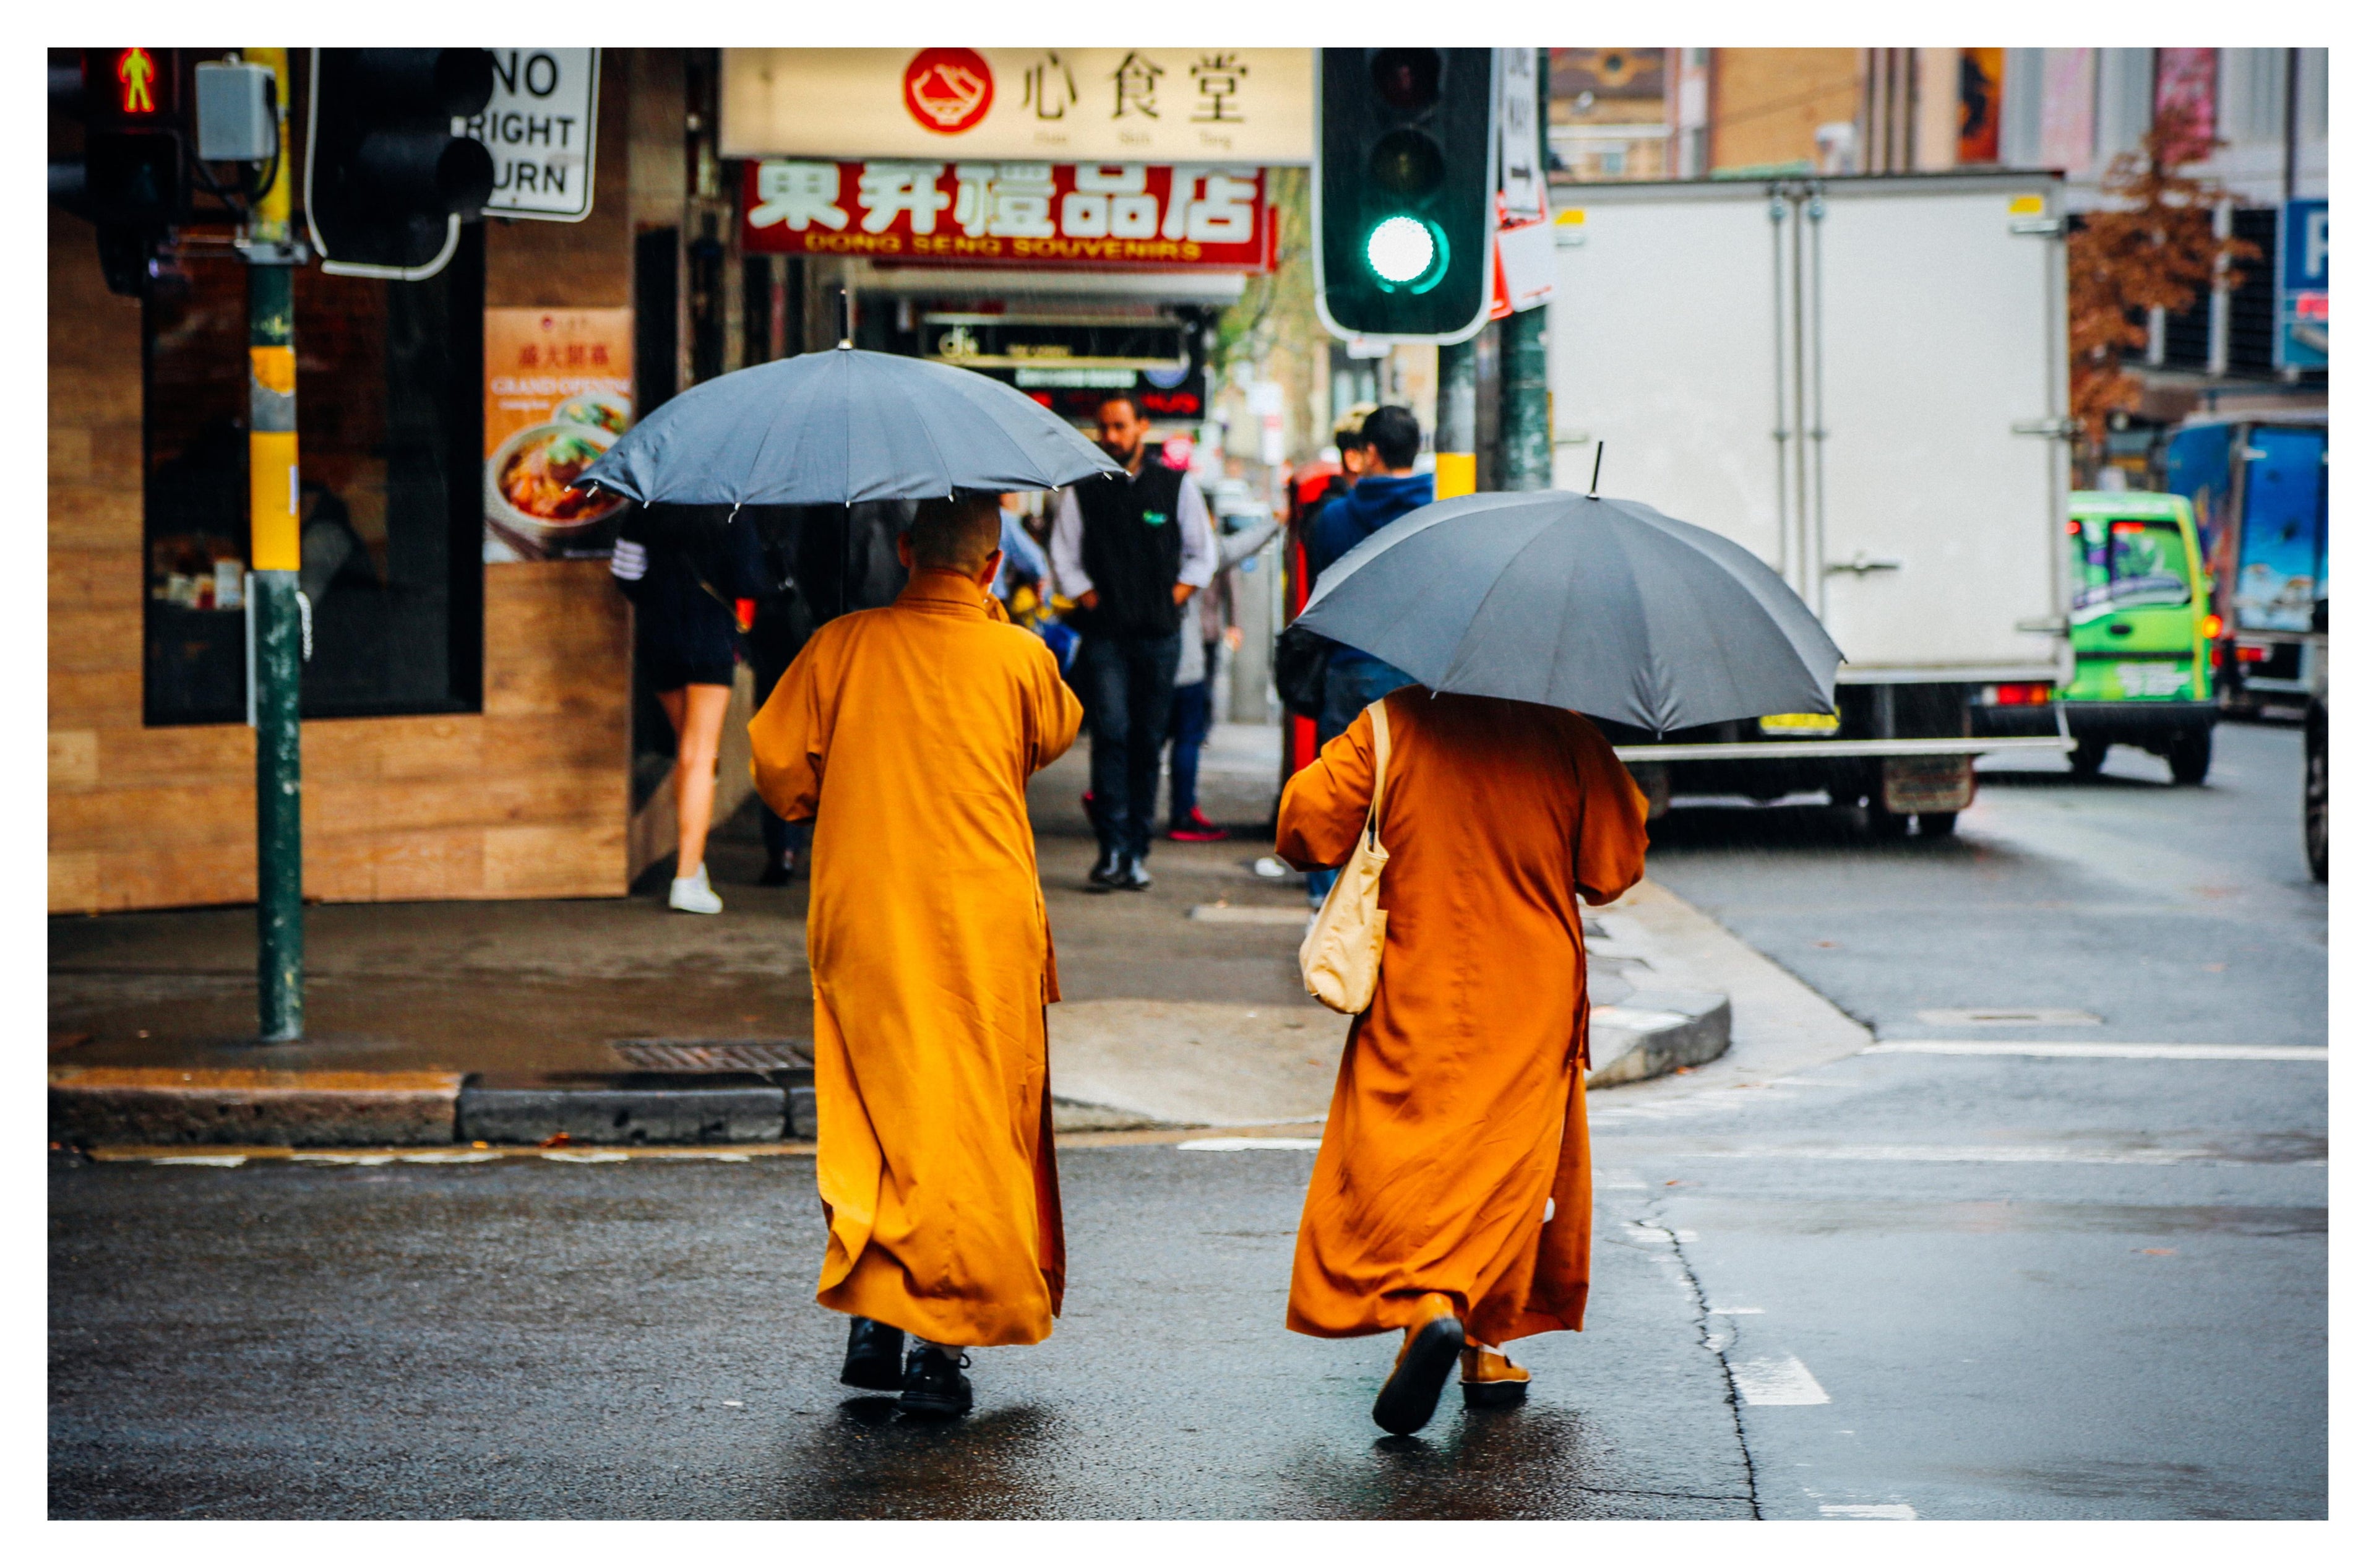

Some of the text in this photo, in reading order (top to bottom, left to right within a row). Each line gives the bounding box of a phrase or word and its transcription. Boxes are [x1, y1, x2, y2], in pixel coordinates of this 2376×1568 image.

[492, 50, 558, 97] NO
[1020, 49, 1247, 123] 心食堂
[494, 161, 566, 194] URN
[806, 231, 1202, 261] DONG SENG SOUVENIRS
